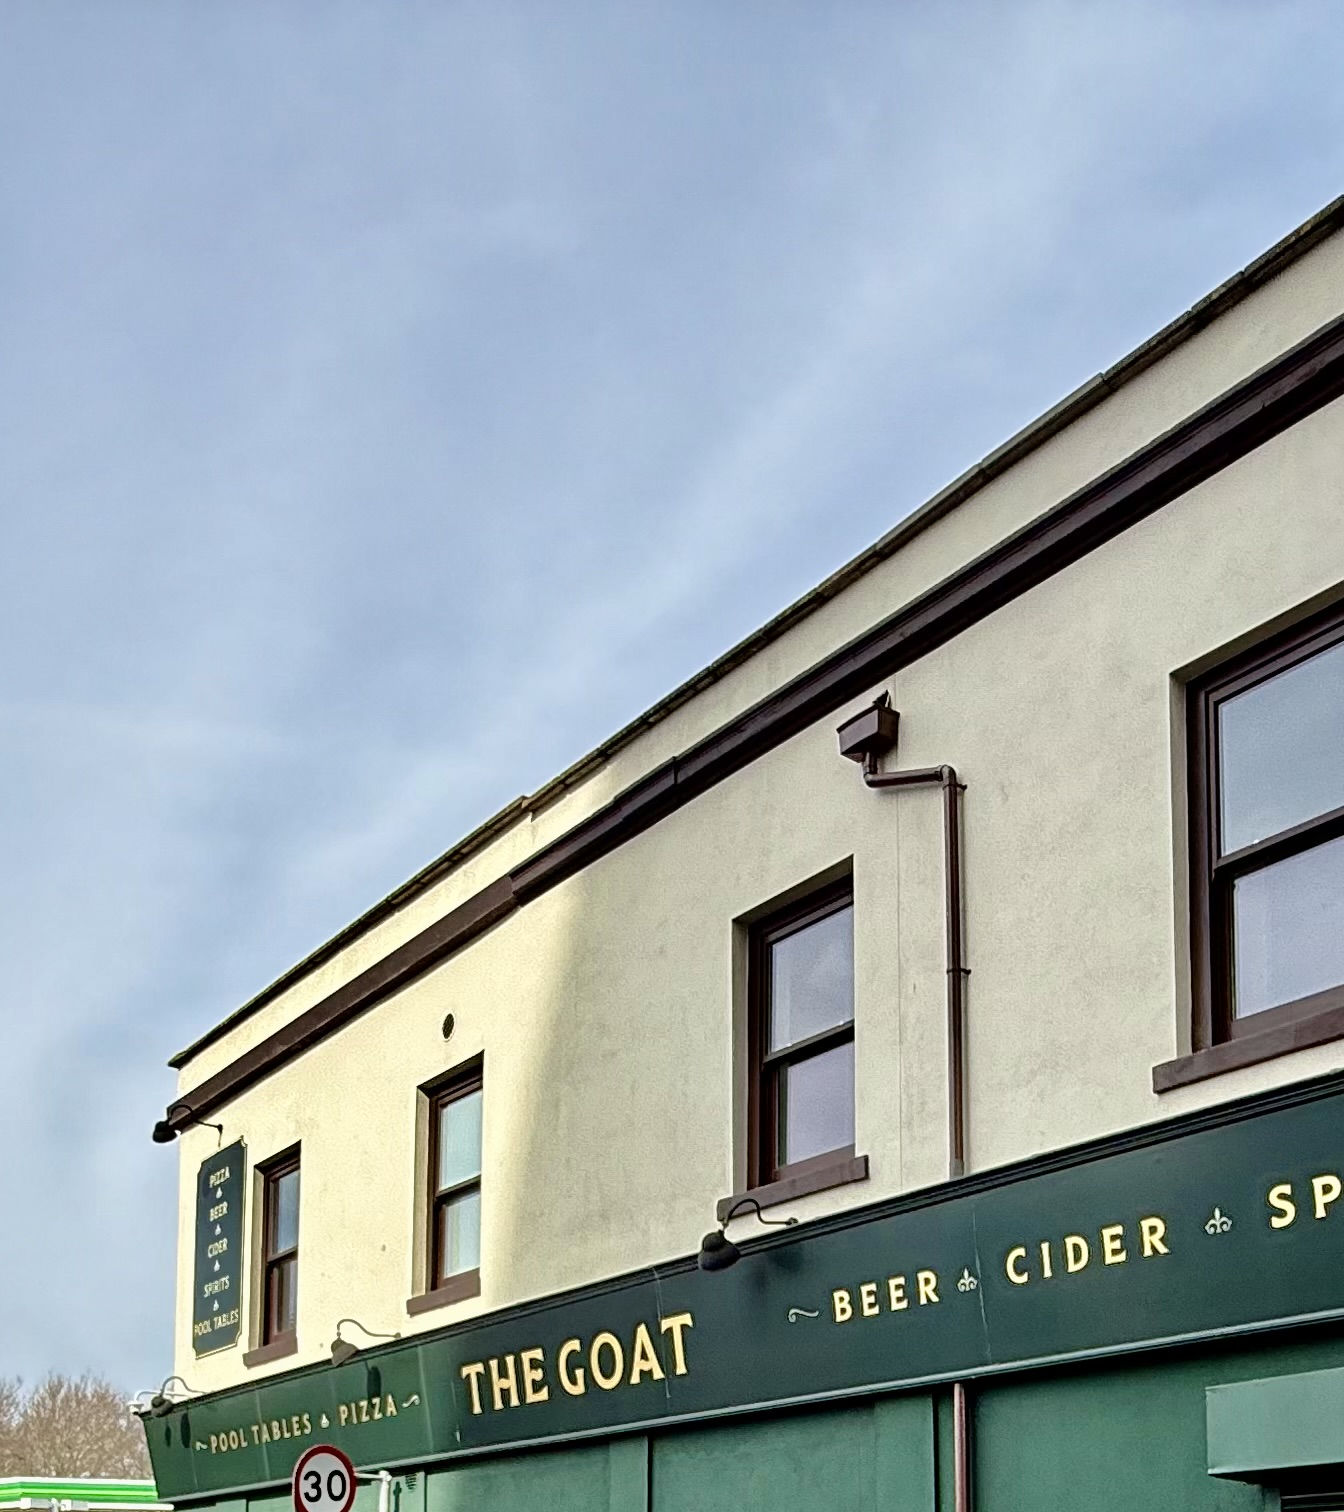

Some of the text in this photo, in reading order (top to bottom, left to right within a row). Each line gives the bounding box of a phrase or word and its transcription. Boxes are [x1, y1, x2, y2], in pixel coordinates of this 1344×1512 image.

[209, 1166, 231, 1189] PIZZA
[209, 1201, 228, 1222] BEER
[207, 1237, 229, 1259] CIDER
[832, 1269, 940, 1324] BEER
[1005, 1216, 1170, 1286] CIDER
[203, 1275, 230, 1298] SPIRITS
[194, 1308, 239, 1336] POOL TABLES
[459, 1311, 695, 1416] THE GOAT
[209, 1393, 398, 1455] POOL TABLES PIZZA
[302, 1468, 348, 1504] 30
